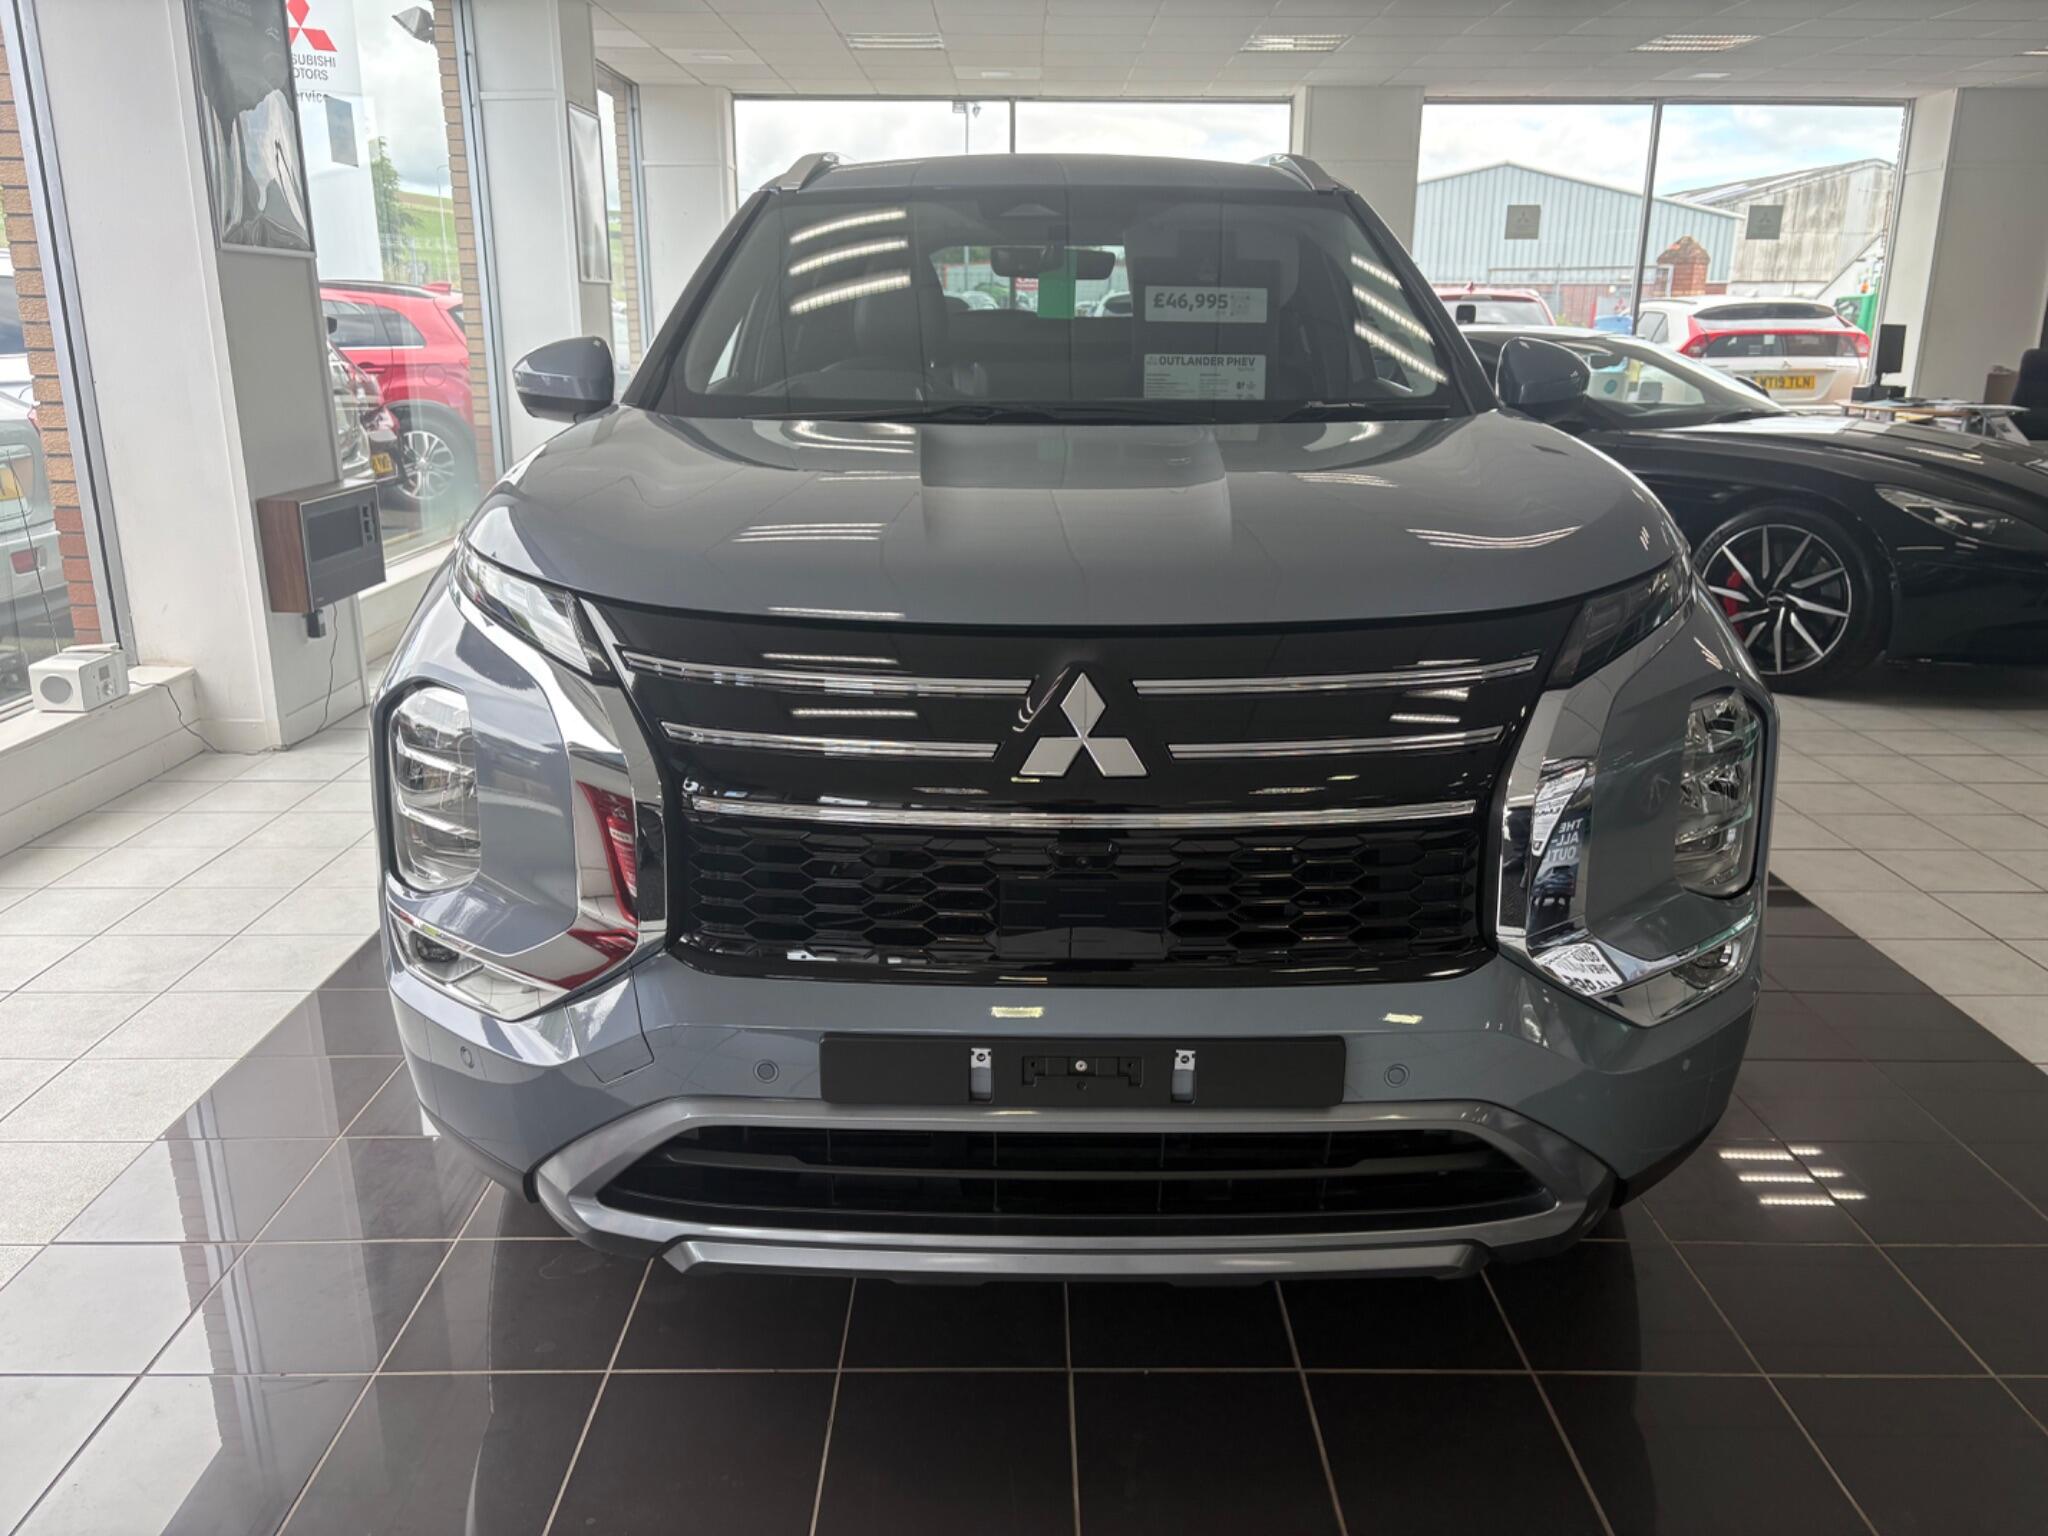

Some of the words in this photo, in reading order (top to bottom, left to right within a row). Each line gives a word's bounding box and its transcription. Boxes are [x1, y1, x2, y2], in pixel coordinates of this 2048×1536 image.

[1153, 292, 1228, 312] £46,995
[1159, 356, 1224, 366] OUTLANDER
[1226, 356, 1256, 367] PHEV
